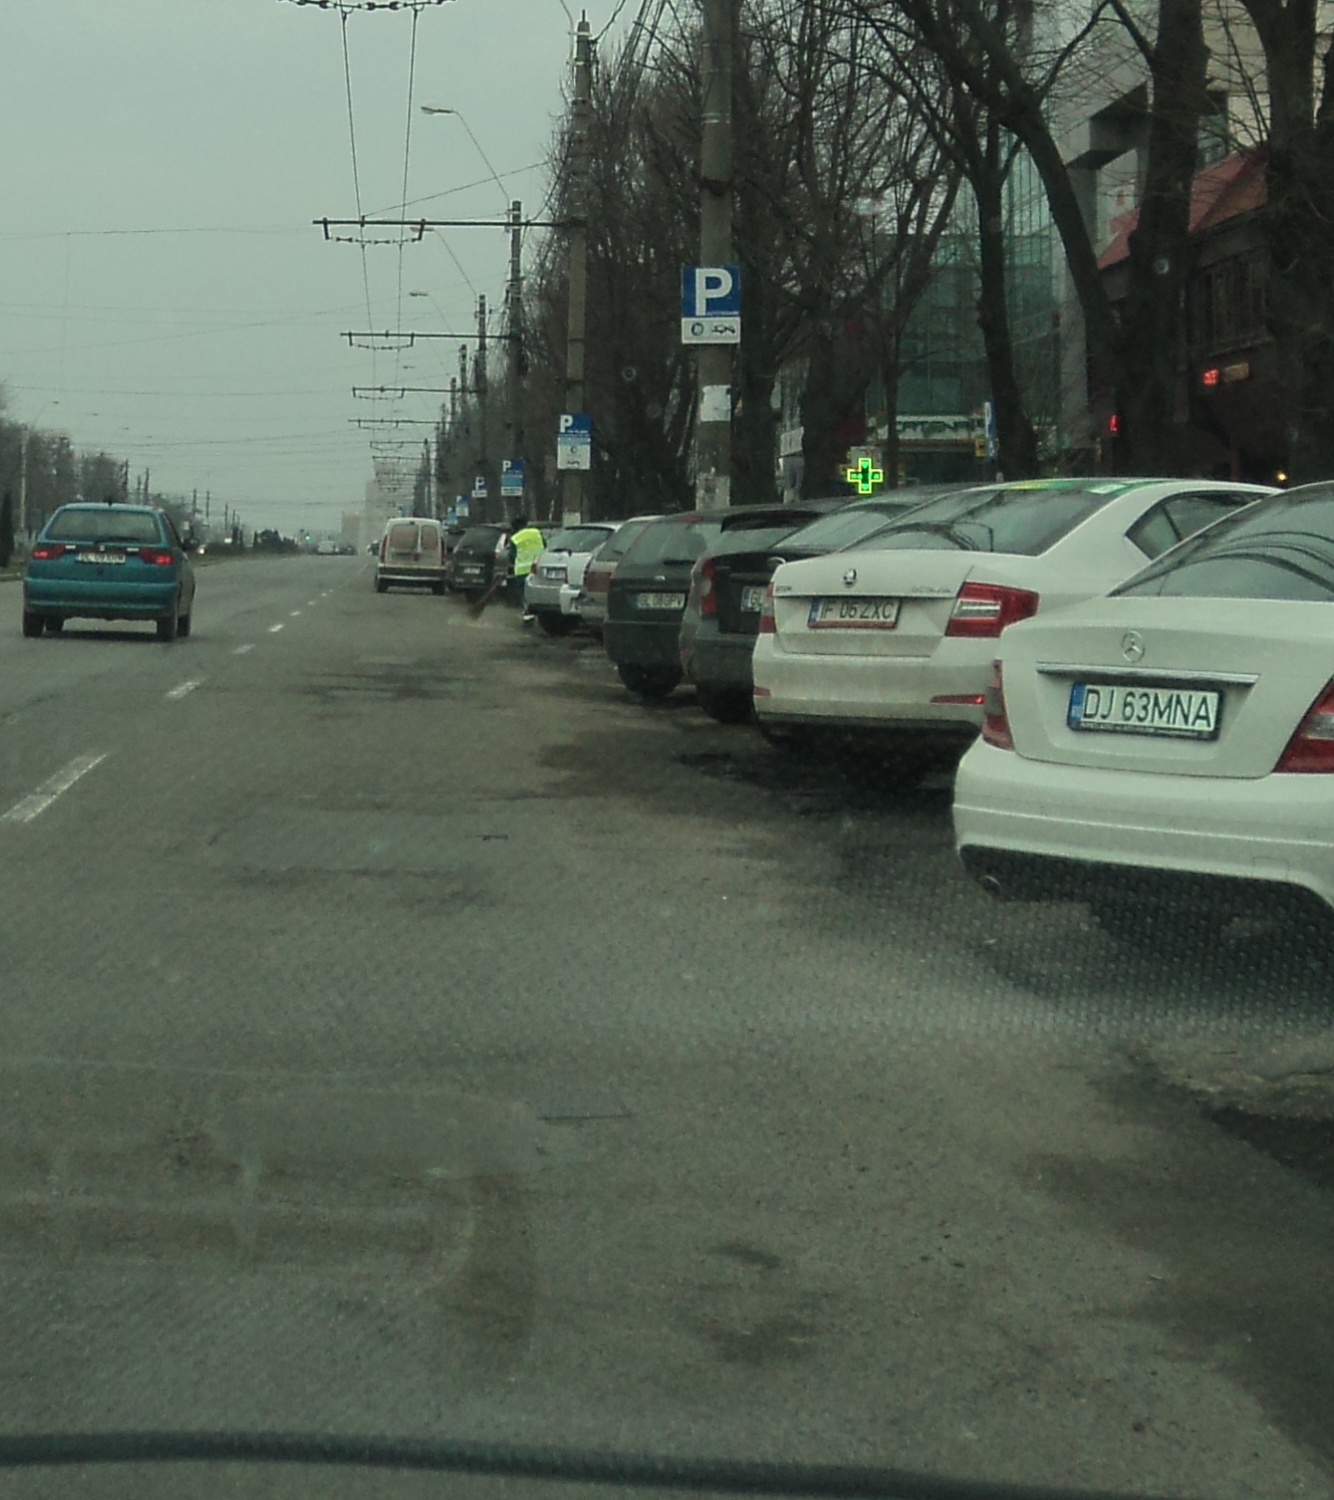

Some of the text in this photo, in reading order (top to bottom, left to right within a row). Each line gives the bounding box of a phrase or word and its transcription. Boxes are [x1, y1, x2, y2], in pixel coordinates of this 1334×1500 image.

[695, 268, 733, 316] P
[559, 413, 574, 433] P
[502, 460, 513, 473] P
[474, 476, 486, 490] P
[820, 599, 835, 619] IF
[860, 599, 894, 620] ZXC
[1083, 688, 1212, 728] DJ 63MNA
